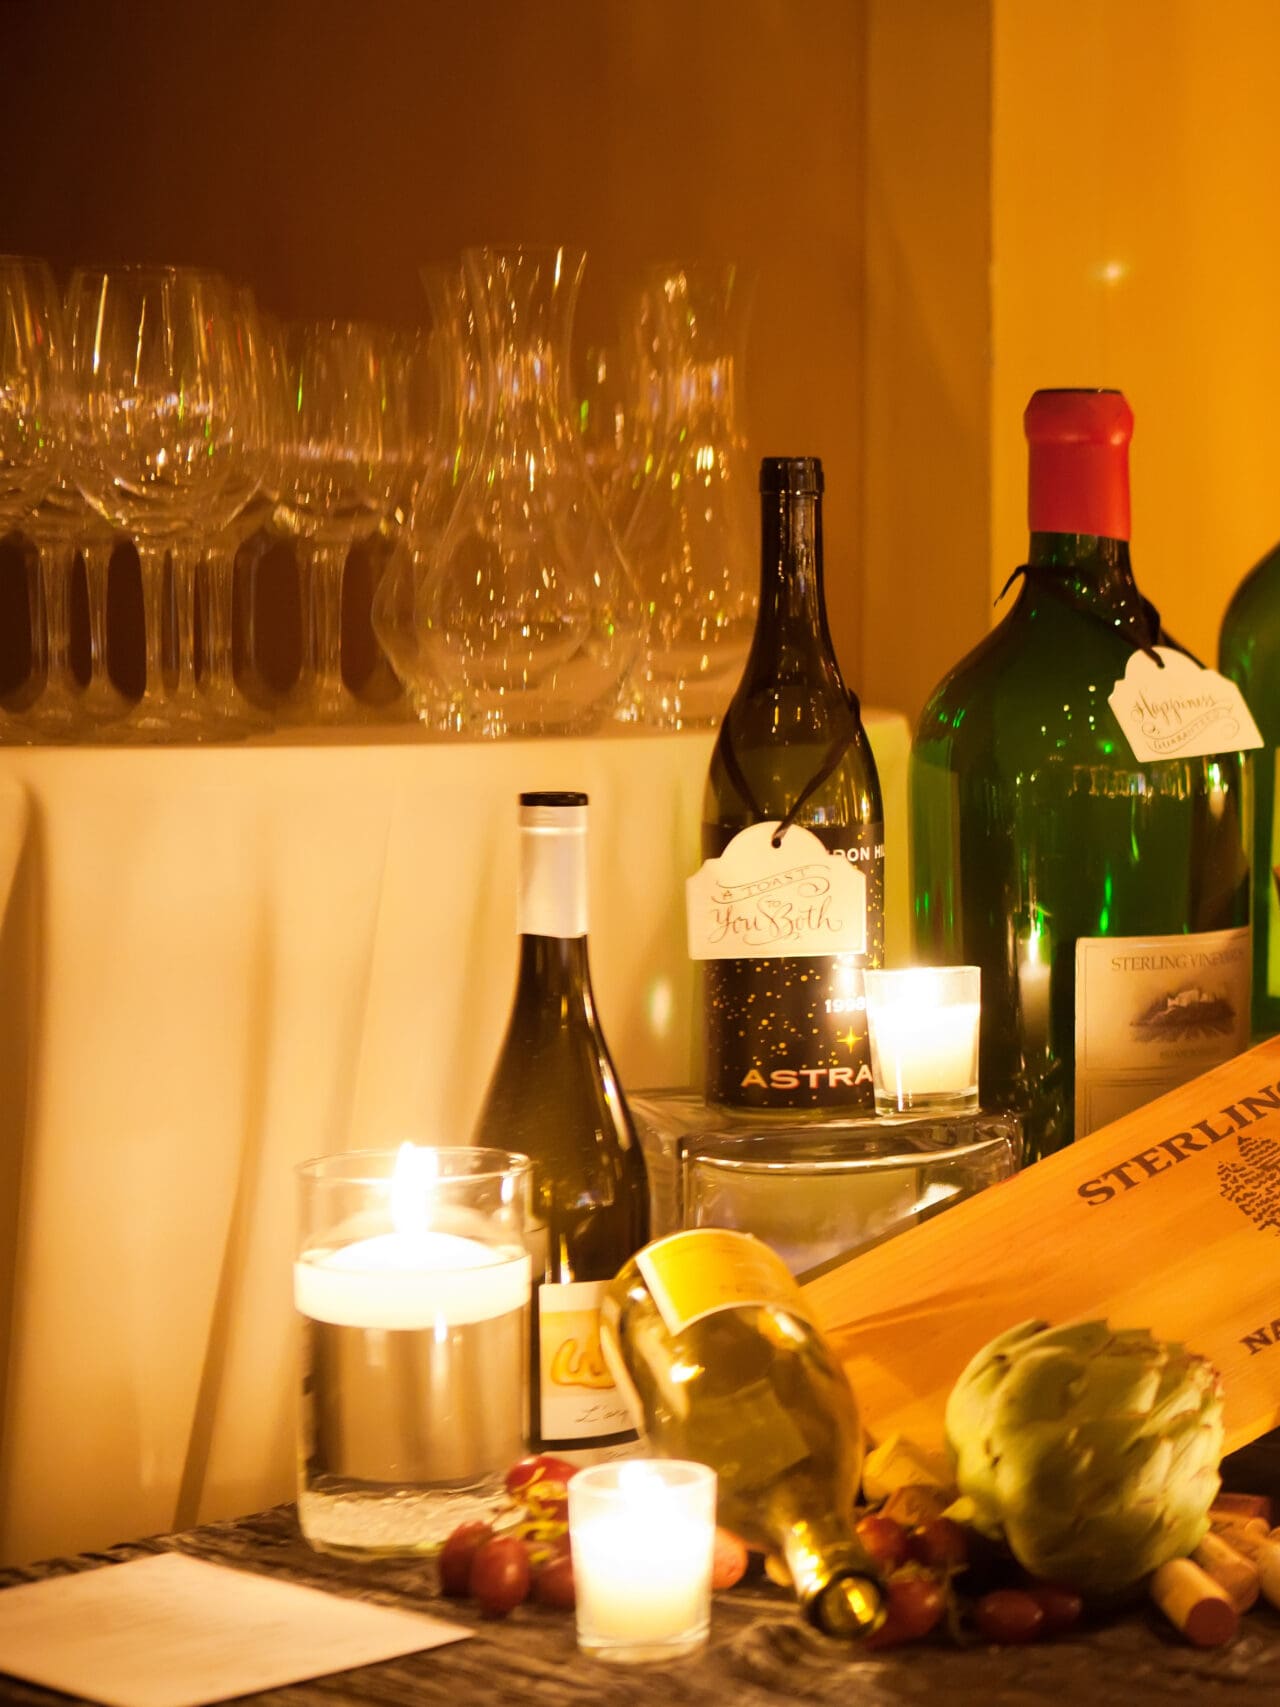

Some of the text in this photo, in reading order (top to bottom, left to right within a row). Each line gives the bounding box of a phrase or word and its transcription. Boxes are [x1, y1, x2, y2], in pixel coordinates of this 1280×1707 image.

[1131, 688, 1218, 732] Happiness
[743, 867, 808, 893] TOAST
[1111, 954, 1186, 973] STERLING
[740, 1064, 874, 1090] ASTRA
